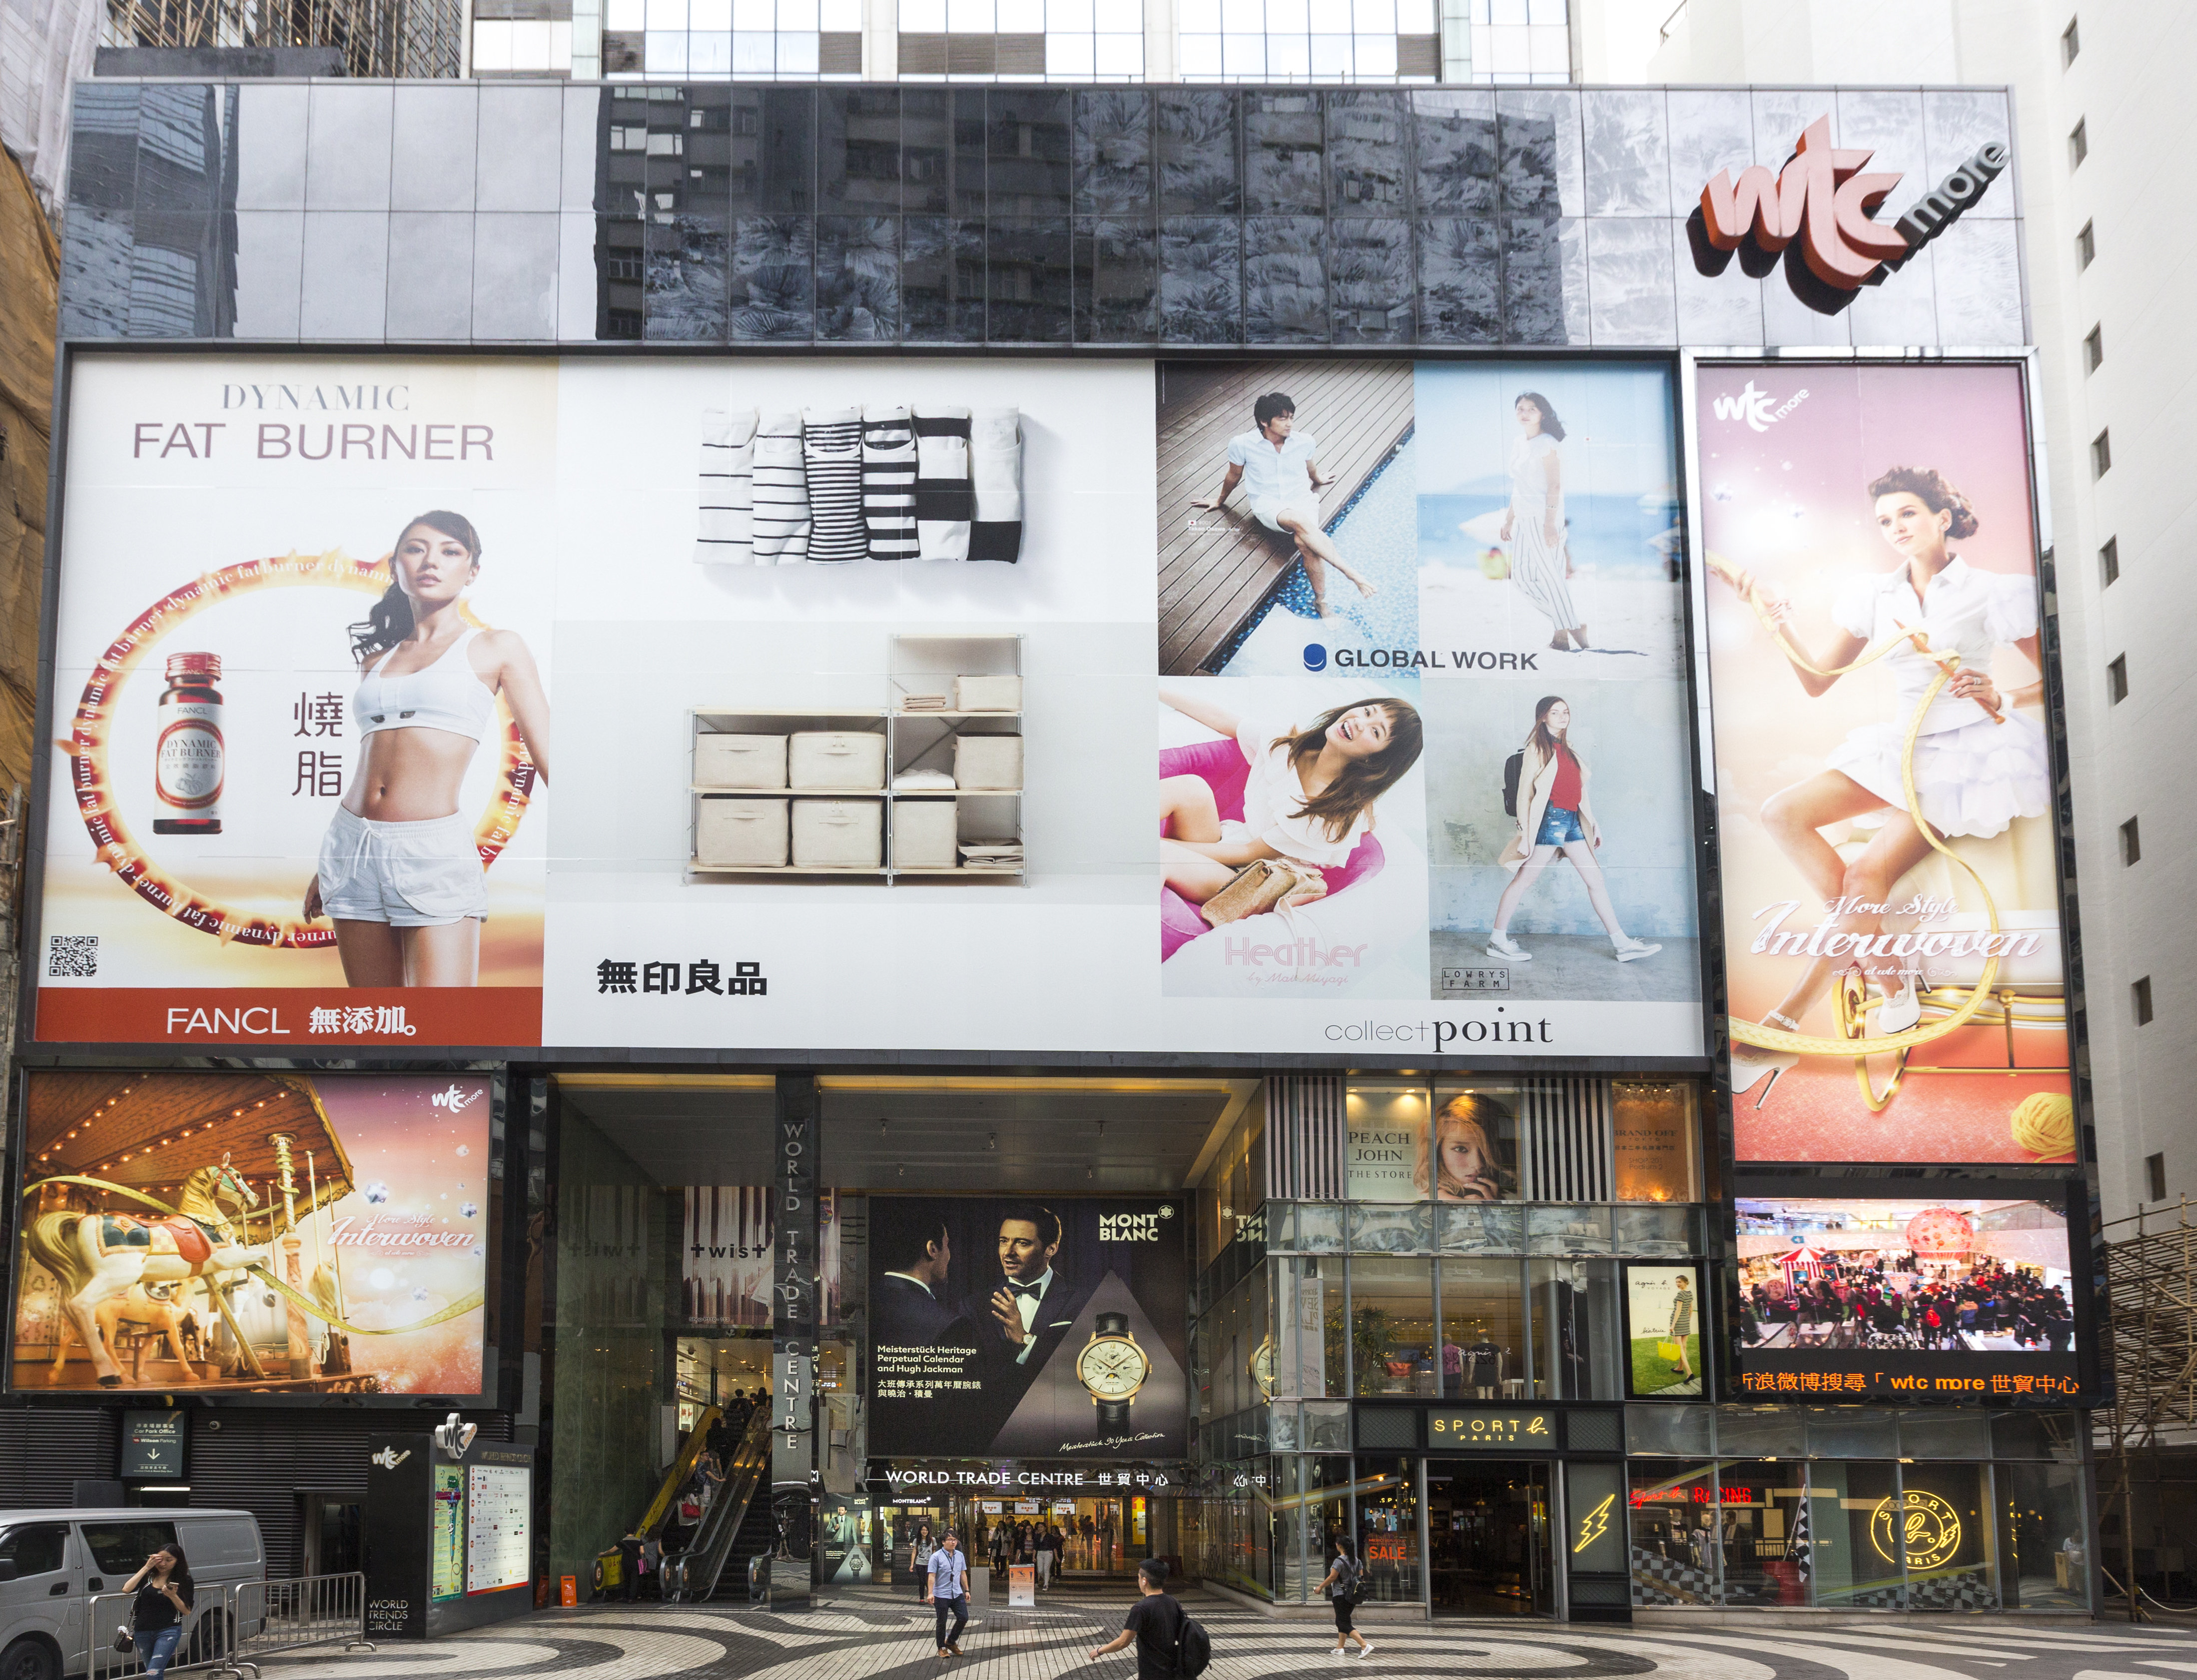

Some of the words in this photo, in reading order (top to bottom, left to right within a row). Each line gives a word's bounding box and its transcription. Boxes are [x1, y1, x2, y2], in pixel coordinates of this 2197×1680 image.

[1696, 112, 1909, 292] wtc
[1895, 140, 2011, 246] more
[220, 384, 409, 411] DYNAMIC
[1713, 380, 1778, 433] wtc
[1773, 388, 1810, 421] more
[132, 423, 226, 458] FAT
[256, 423, 494, 461] BURNER
[237, 564, 259, 580] fat
[262, 560, 325, 574] burner
[166, 571, 234, 611] dynamic
[114, 609, 164, 653] burner
[1335, 648, 1446, 670] GLOBAL
[1452, 651, 1539, 672] WORK
[76, 673, 110, 736] dynamic
[161, 750, 177, 759] FAT
[179, 749, 222, 759] BURNER
[166, 740, 216, 749] DYNAMIC
[292, 692, 343, 797] 燒脂
[76, 739, 94, 792] burner
[501, 761, 535, 824] dynamic
[82, 795, 99, 815] fat
[90, 816, 136, 874] dynamic
[132, 873, 186, 917] burner
[181, 905, 208, 927] fat
[1822, 895, 1891, 918] More
[1895, 893, 1961, 923] Style
[209, 917, 283, 946] dynamic
[288, 930, 337, 942] urner
[1751, 899, 2045, 959] Interwoven
[1225, 936, 1368, 967] Heather
[597, 958, 767, 996] 無印良品
[1247, 972, 1264, 986] by
[1300, 973, 1349, 987] Miyagi
[166, 1006, 290, 1034] FANCL
[431, 1083, 466, 1113] wtc
[464, 1088, 484, 1106] more
[1348, 1131, 1410, 1144] PEACH
[1355, 1149, 1404, 1161] JOHN
[784, 1123, 805, 1212] WORLD
[1375, 1170, 1412, 1179] STORE
[327, 1215, 475, 1246] Interwoven
[366, 1212, 401, 1224] More
[404, 1212, 436, 1228] Style
[1099, 1214, 1158, 1228] MONT
[1099, 1228, 1159, 1242] BLANC
[691, 1243, 766, 1259] twist
[784, 1230, 800, 1319] TRADE
[877, 1345, 936, 1354] Meisterstück
[937, 1346, 977, 1356] Heritage
[877, 1354, 921, 1364] Perpetual
[923, 1355, 965, 1363] Calendar
[896, 1365, 921, 1374] Hugh
[922, 1365, 963, 1373] Jackman
[1890, 1376, 1928, 1391] wtc
[1935, 1377, 1985, 1391] more
[1989, 1374, 2080, 1394] 世貿中心
[783, 1341, 800, 1450] CENTRE
[1435, 1419, 1520, 1432] SPORT
[444, 1424, 466, 1457] wtc
[463, 1425, 477, 1447] more
[1104, 1437, 1114, 1446] 90
[372, 1446, 398, 1469] wtc
[395, 1449, 411, 1465] more
[885, 1471, 950, 1485] WORLD
[956, 1471, 1011, 1485] TRADE
[1017, 1472, 1084, 1486] CENTRE
[1098, 1473, 1169, 1487] 世貿中心
[1878, 1494, 1953, 1521] SORT
[1369, 1546, 1407, 1560] SALE
[1905, 1553, 1941, 1565] ARIS
[369, 1600, 408, 1609] WORLD
[369, 1610, 408, 1619] TRENDS
[369, 1622, 403, 1630] CIRCLE
